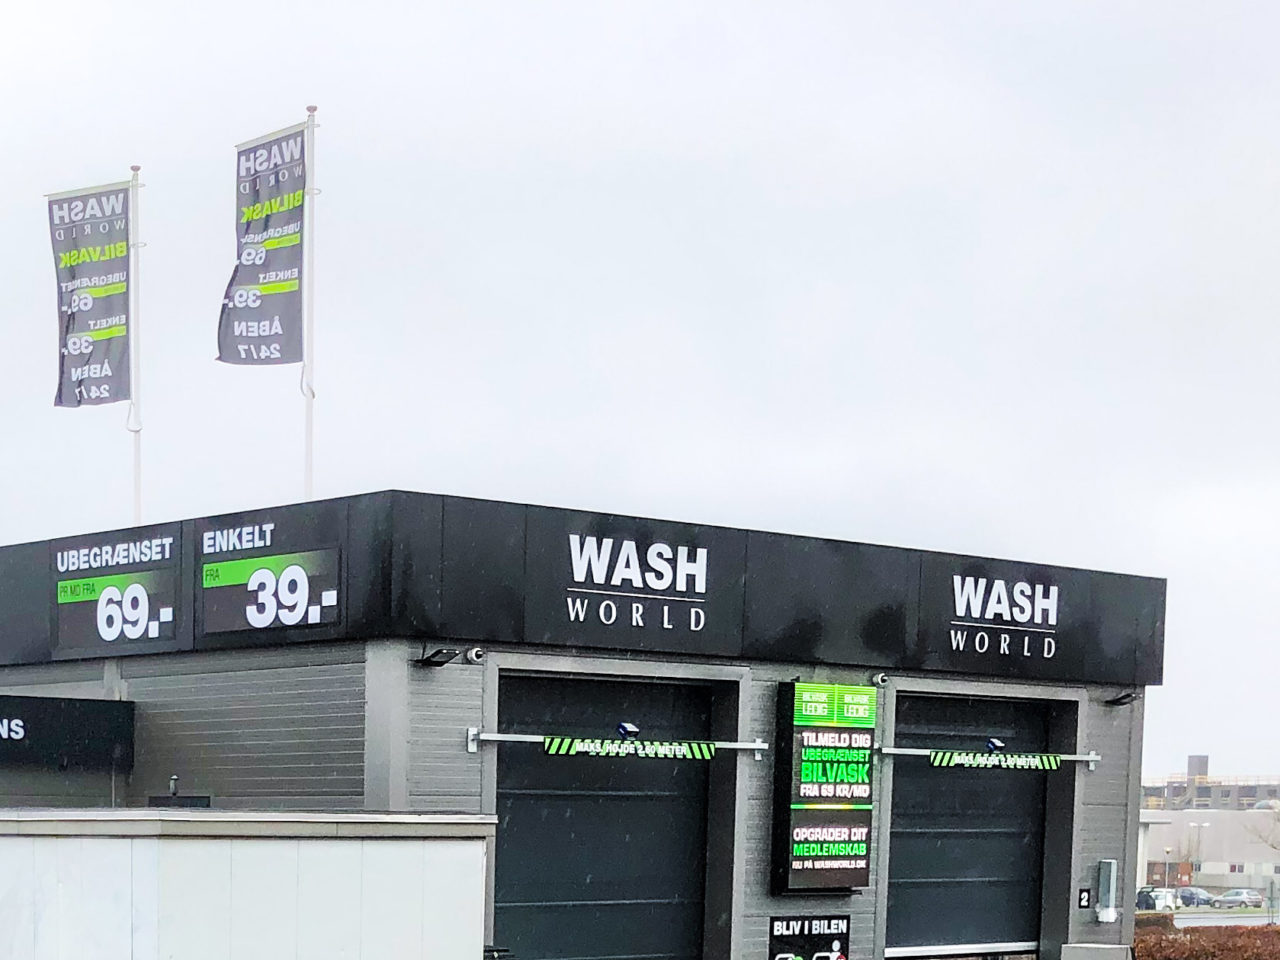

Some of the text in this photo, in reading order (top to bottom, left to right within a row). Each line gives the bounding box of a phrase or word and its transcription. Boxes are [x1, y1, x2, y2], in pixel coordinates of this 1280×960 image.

[202, 523, 275, 554] ENKELT
[56, 537, 174, 572] UBEGRÆNSET
[568, 533, 708, 594] WASH
[205, 569, 221, 582] FRA
[82, 582, 96, 595] FRA
[245, 564, 338, 629] 39.-
[952, 575, 1059, 626] WASH
[96, 583, 174, 642] 69.-
[567, 597, 706, 633] WORLD
[950, 630, 1057, 660] WORLD
[802, 732, 871, 748] TILMELD DIG
[801, 763, 869, 783] BILVASK
[800, 783, 820, 797] FRA
[793, 827, 868, 842] OPGRADER DIT
[792, 843, 867, 857] MEDLEMSKAB
[1080, 891, 1089, 907] 2
[773, 919, 847, 936] BLIV I BILEN
